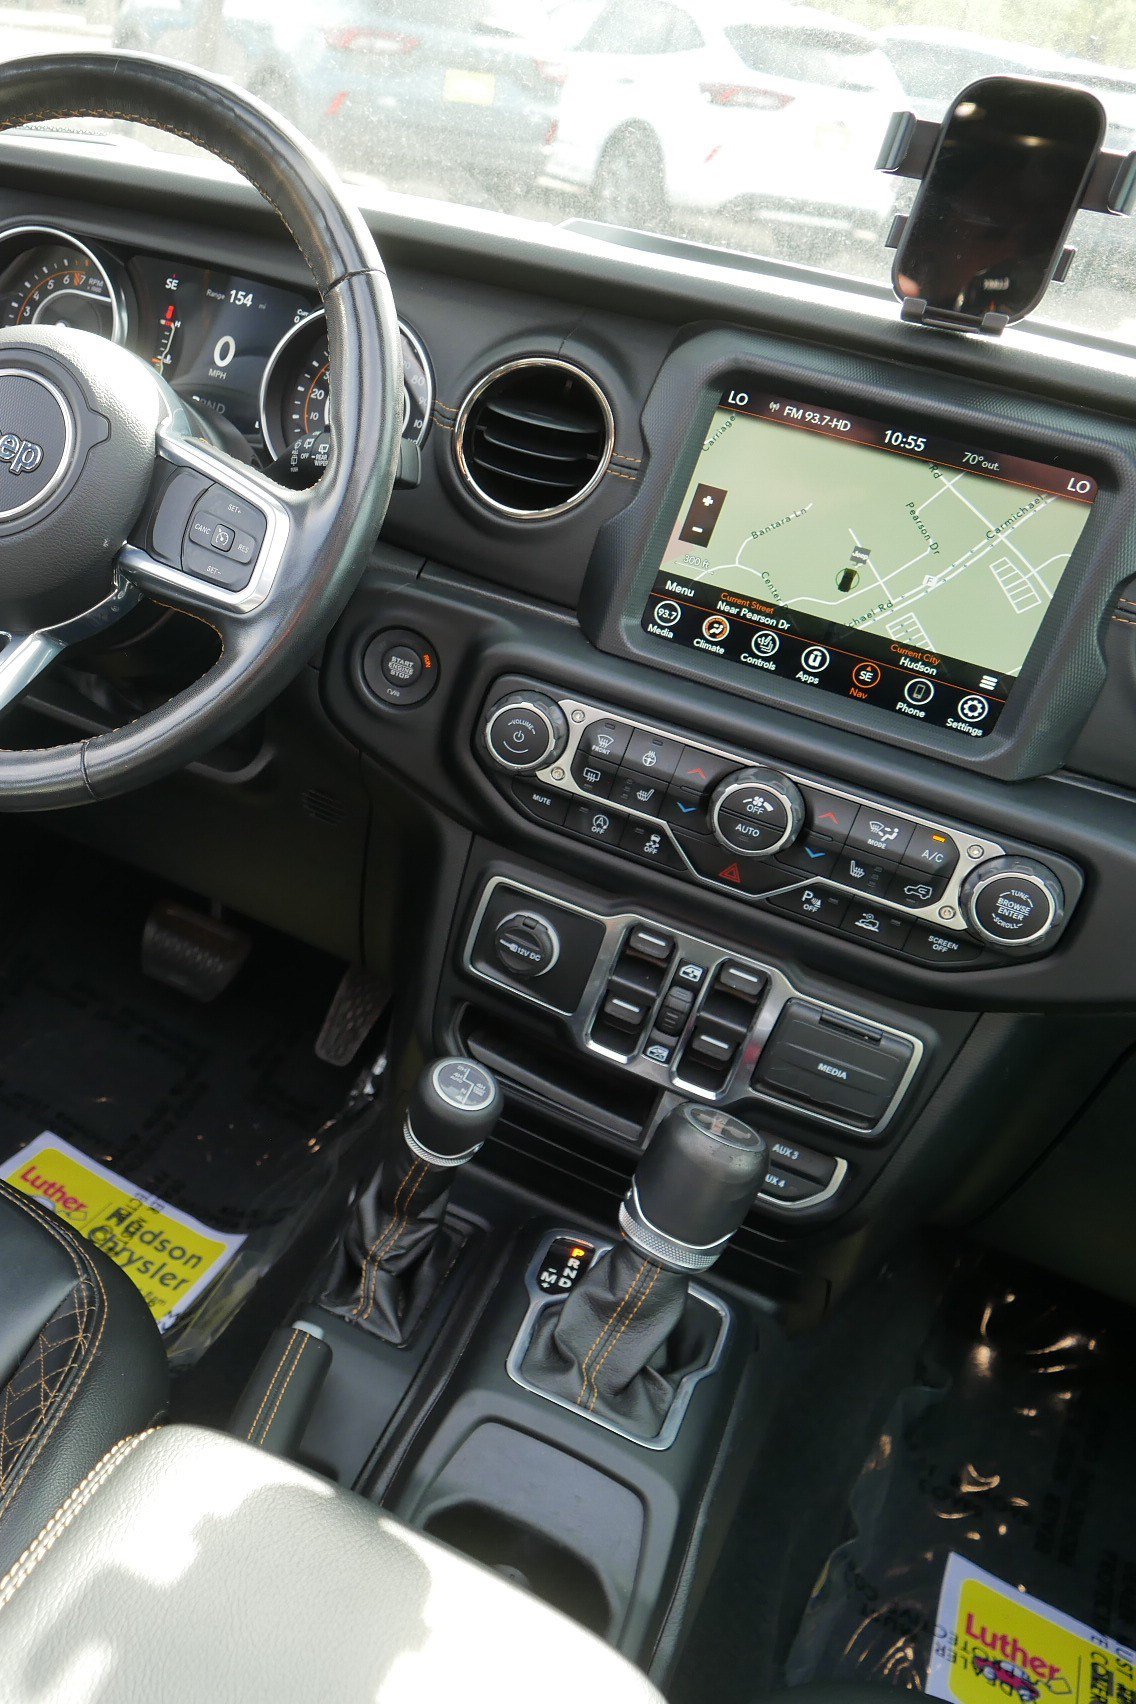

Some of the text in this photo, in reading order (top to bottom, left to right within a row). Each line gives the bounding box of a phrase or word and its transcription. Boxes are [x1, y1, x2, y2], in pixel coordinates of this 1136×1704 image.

[47, 280, 54, 290] 5
[64, 274, 70, 284] 6
[88, 278, 104, 287] RPM
[165, 278, 179, 290] SE
[33, 290, 40, 300] 4
[206, 289, 226, 300] Range
[229, 289, 254, 307] 154
[24, 306, 31, 316] 3
[214, 335, 236, 368] 0
[208, 368, 227, 380] MPH
[310, 388, 324, 400] 20
[728, 390, 748, 406] LO
[310, 412, 318, 420] 10
[783, 406, 851, 432] FM 93.7-HD
[702, 414, 736, 452] Carriage
[884, 430, 927, 452] 10:55
[1067, 477, 1090, 494] LO
[986, 493, 1045, 540] Carmichael
[194, 524, 211, 534] CANC
[751, 508, 807, 540] Bantara Ln
[906, 501, 940, 556] Pearson Dr
[238, 544, 249, 554] RES
[684, 554, 701, 567] 300
[666, 580, 695, 598] Menu
[761, 571, 782, 602] Center
[720, 592, 774, 615] Current Street
[878, 600, 894, 614] Rd
[658, 608, 677, 620] 93.7
[716, 600, 790, 631] Near Pearson Dr
[648, 624, 674, 639] Media
[693, 638, 725, 655] Climate
[890, 644, 942, 666] Current City
[392, 656, 414, 668] START
[740, 654, 776, 671] Controls
[900, 657, 937, 676] Hudson
[390, 670, 410, 679] STOP
[796, 671, 820, 685] Apps
[860, 671, 874, 682] SE
[849, 687, 868, 700] Nav
[896, 702, 926, 718] Phone
[512, 718, 534, 731] VOLUME
[946, 718, 983, 736] Settings
[592, 744, 610, 756] FRONT
[532, 793, 552, 806] MUTE
[746, 804, 764, 816] OFF
[591, 824, 606, 835] OFF
[736, 823, 760, 838] AUTO
[644, 846, 658, 855] OFF
[868, 838, 887, 850] MODE
[922, 849, 944, 864] A/C
[1011, 890, 1030, 900] TUNE
[803, 904, 818, 914] OFF
[997, 897, 1031, 912] BROWSE
[998, 906, 1024, 920] ENTER
[994, 916, 1018, 929] SCROLL
[928, 935, 958, 951] SCREEN
[932, 942, 950, 954] OFF
[530, 952, 542, 962] DC
[818, 1062, 848, 1080] MEDIA
[772, 1144, 800, 1160] AUX 3
[764, 1174, 786, 1188] UX 4
[20, 1166, 88, 1213] Luther
[87, 1225, 191, 1293] Chrysler
[572, 1248, 585, 1257] P
[567, 1258, 580, 1269] R
[540, 1271, 558, 1284] M
[563, 1267, 578, 1279] N
[558, 1278, 572, 1288] D
[965, 1611, 1062, 1680] Luther
